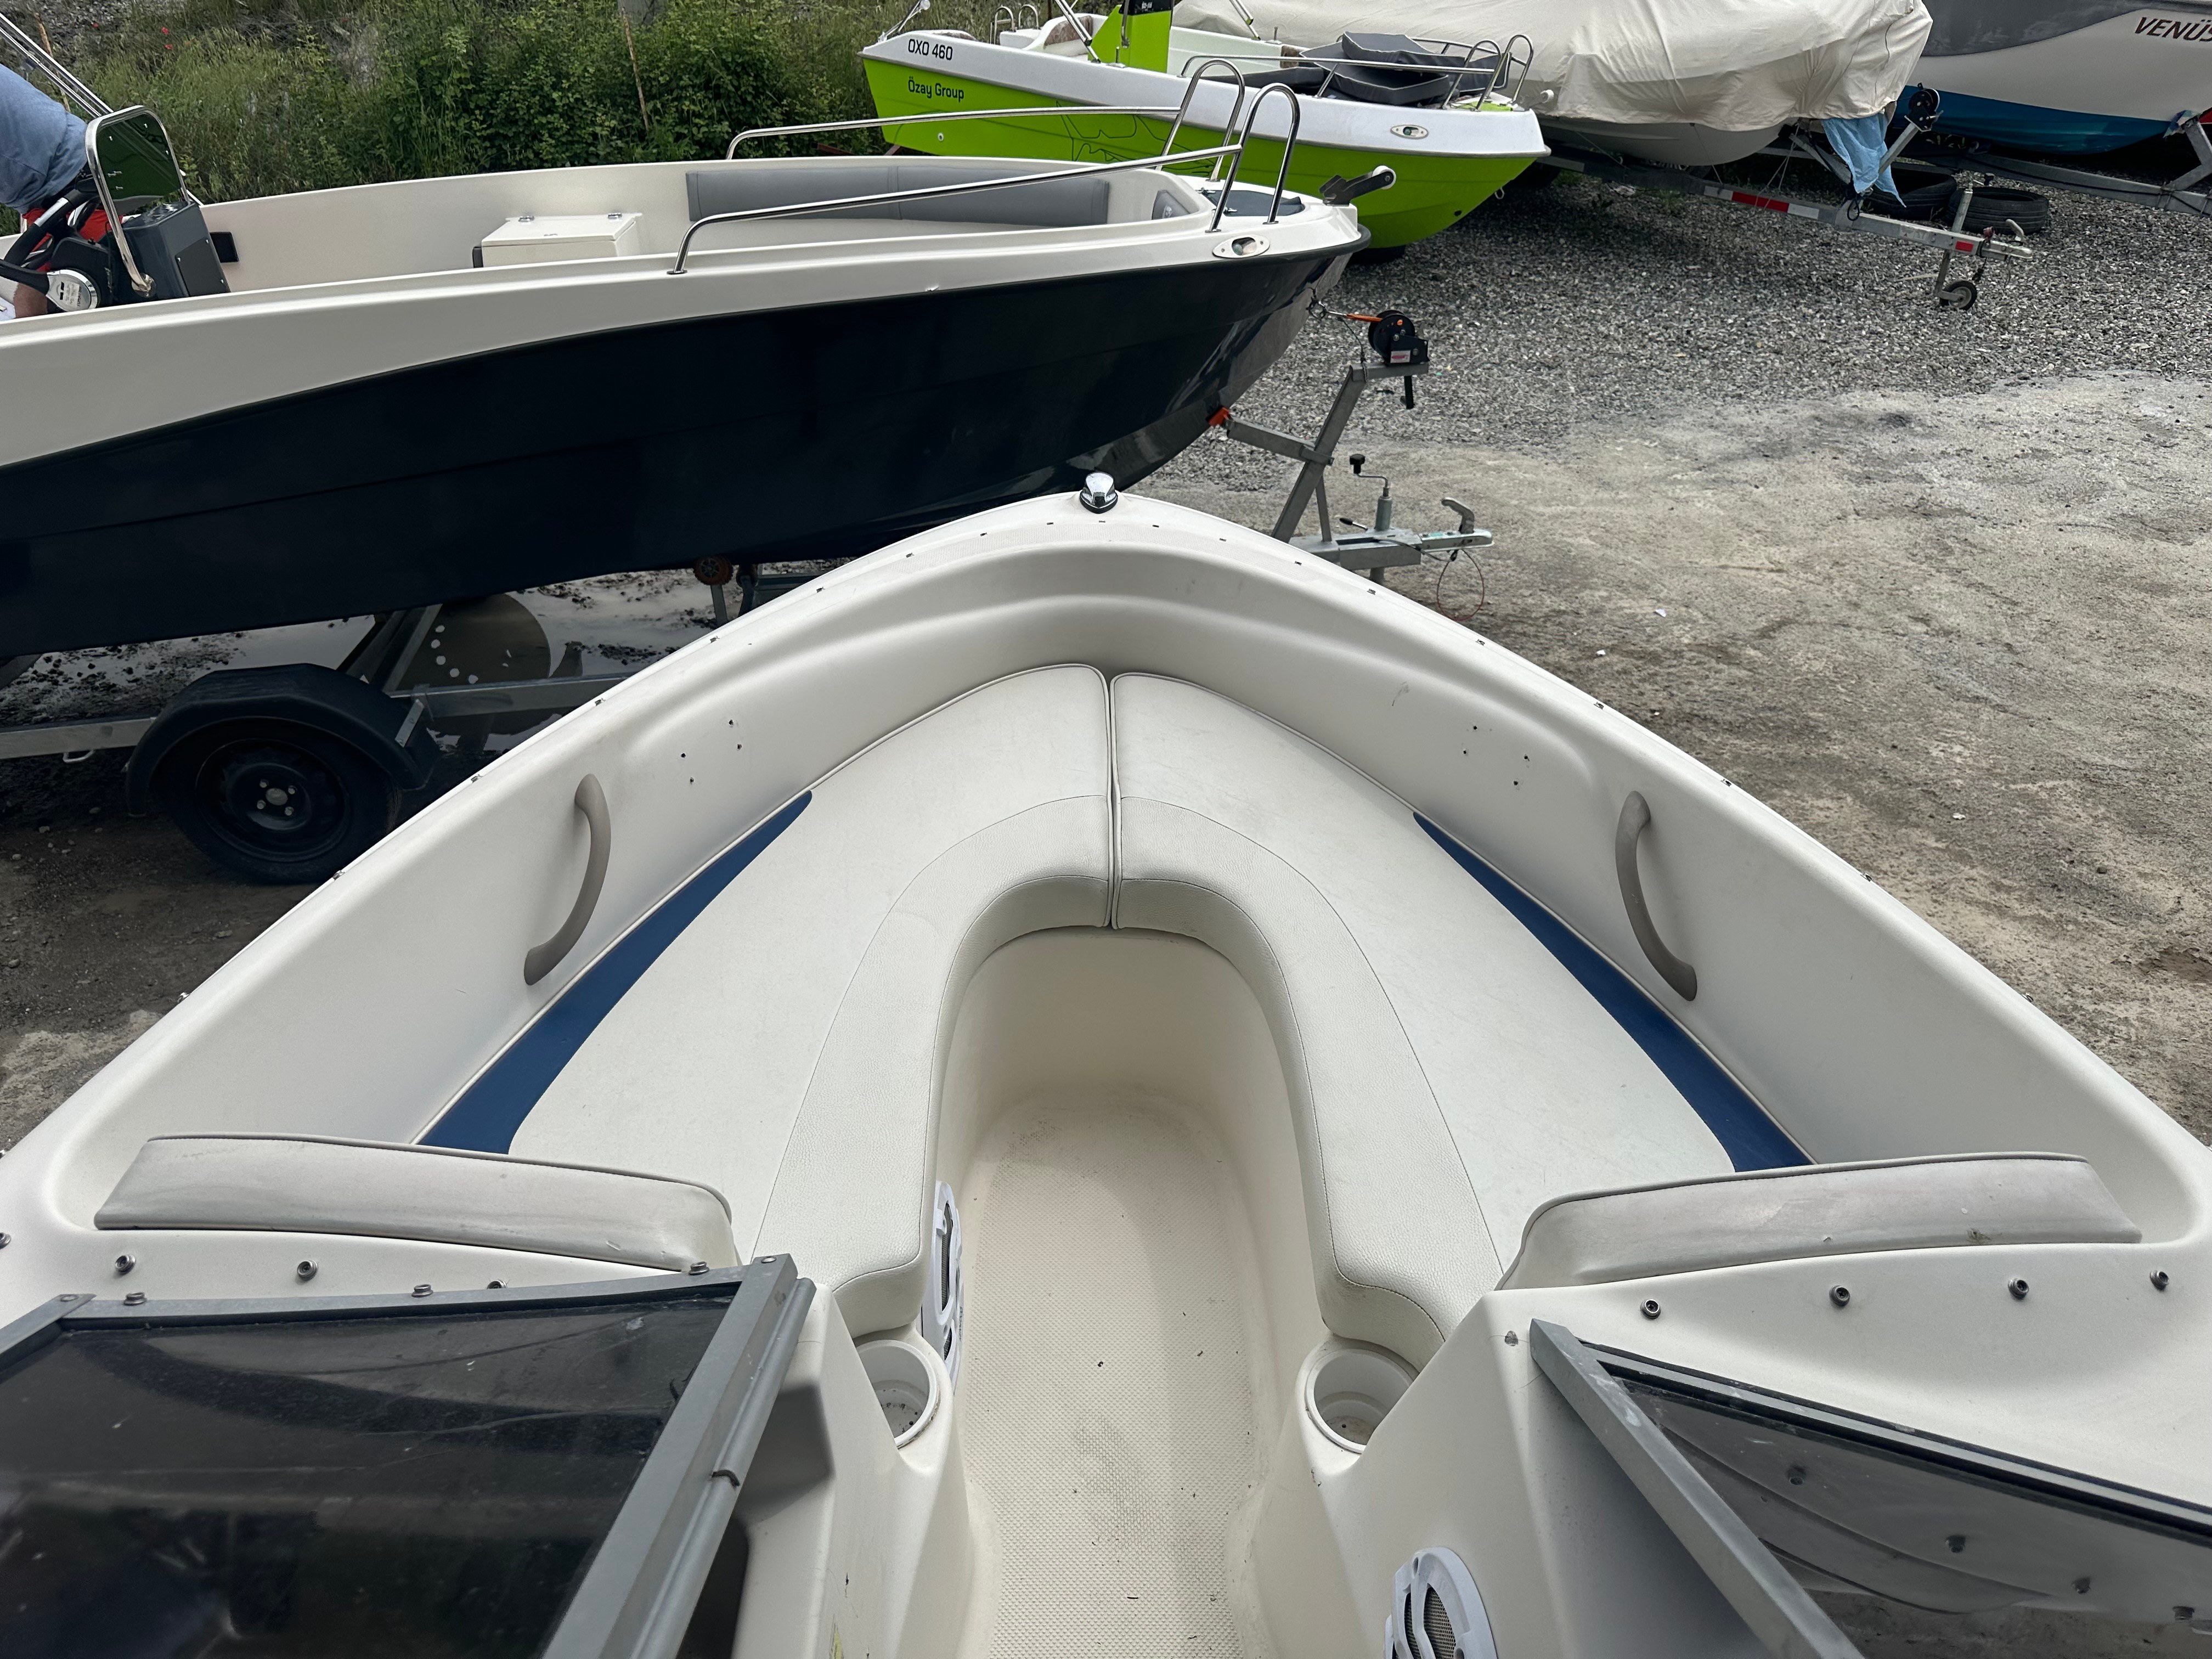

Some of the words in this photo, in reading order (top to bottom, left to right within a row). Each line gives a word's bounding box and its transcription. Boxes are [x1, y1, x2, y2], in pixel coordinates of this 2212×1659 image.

[909, 38, 929, 56] OXO
[932, 44, 953, 60] 460
[908, 76, 932, 99] Özay
[935, 83, 964, 103] Group
